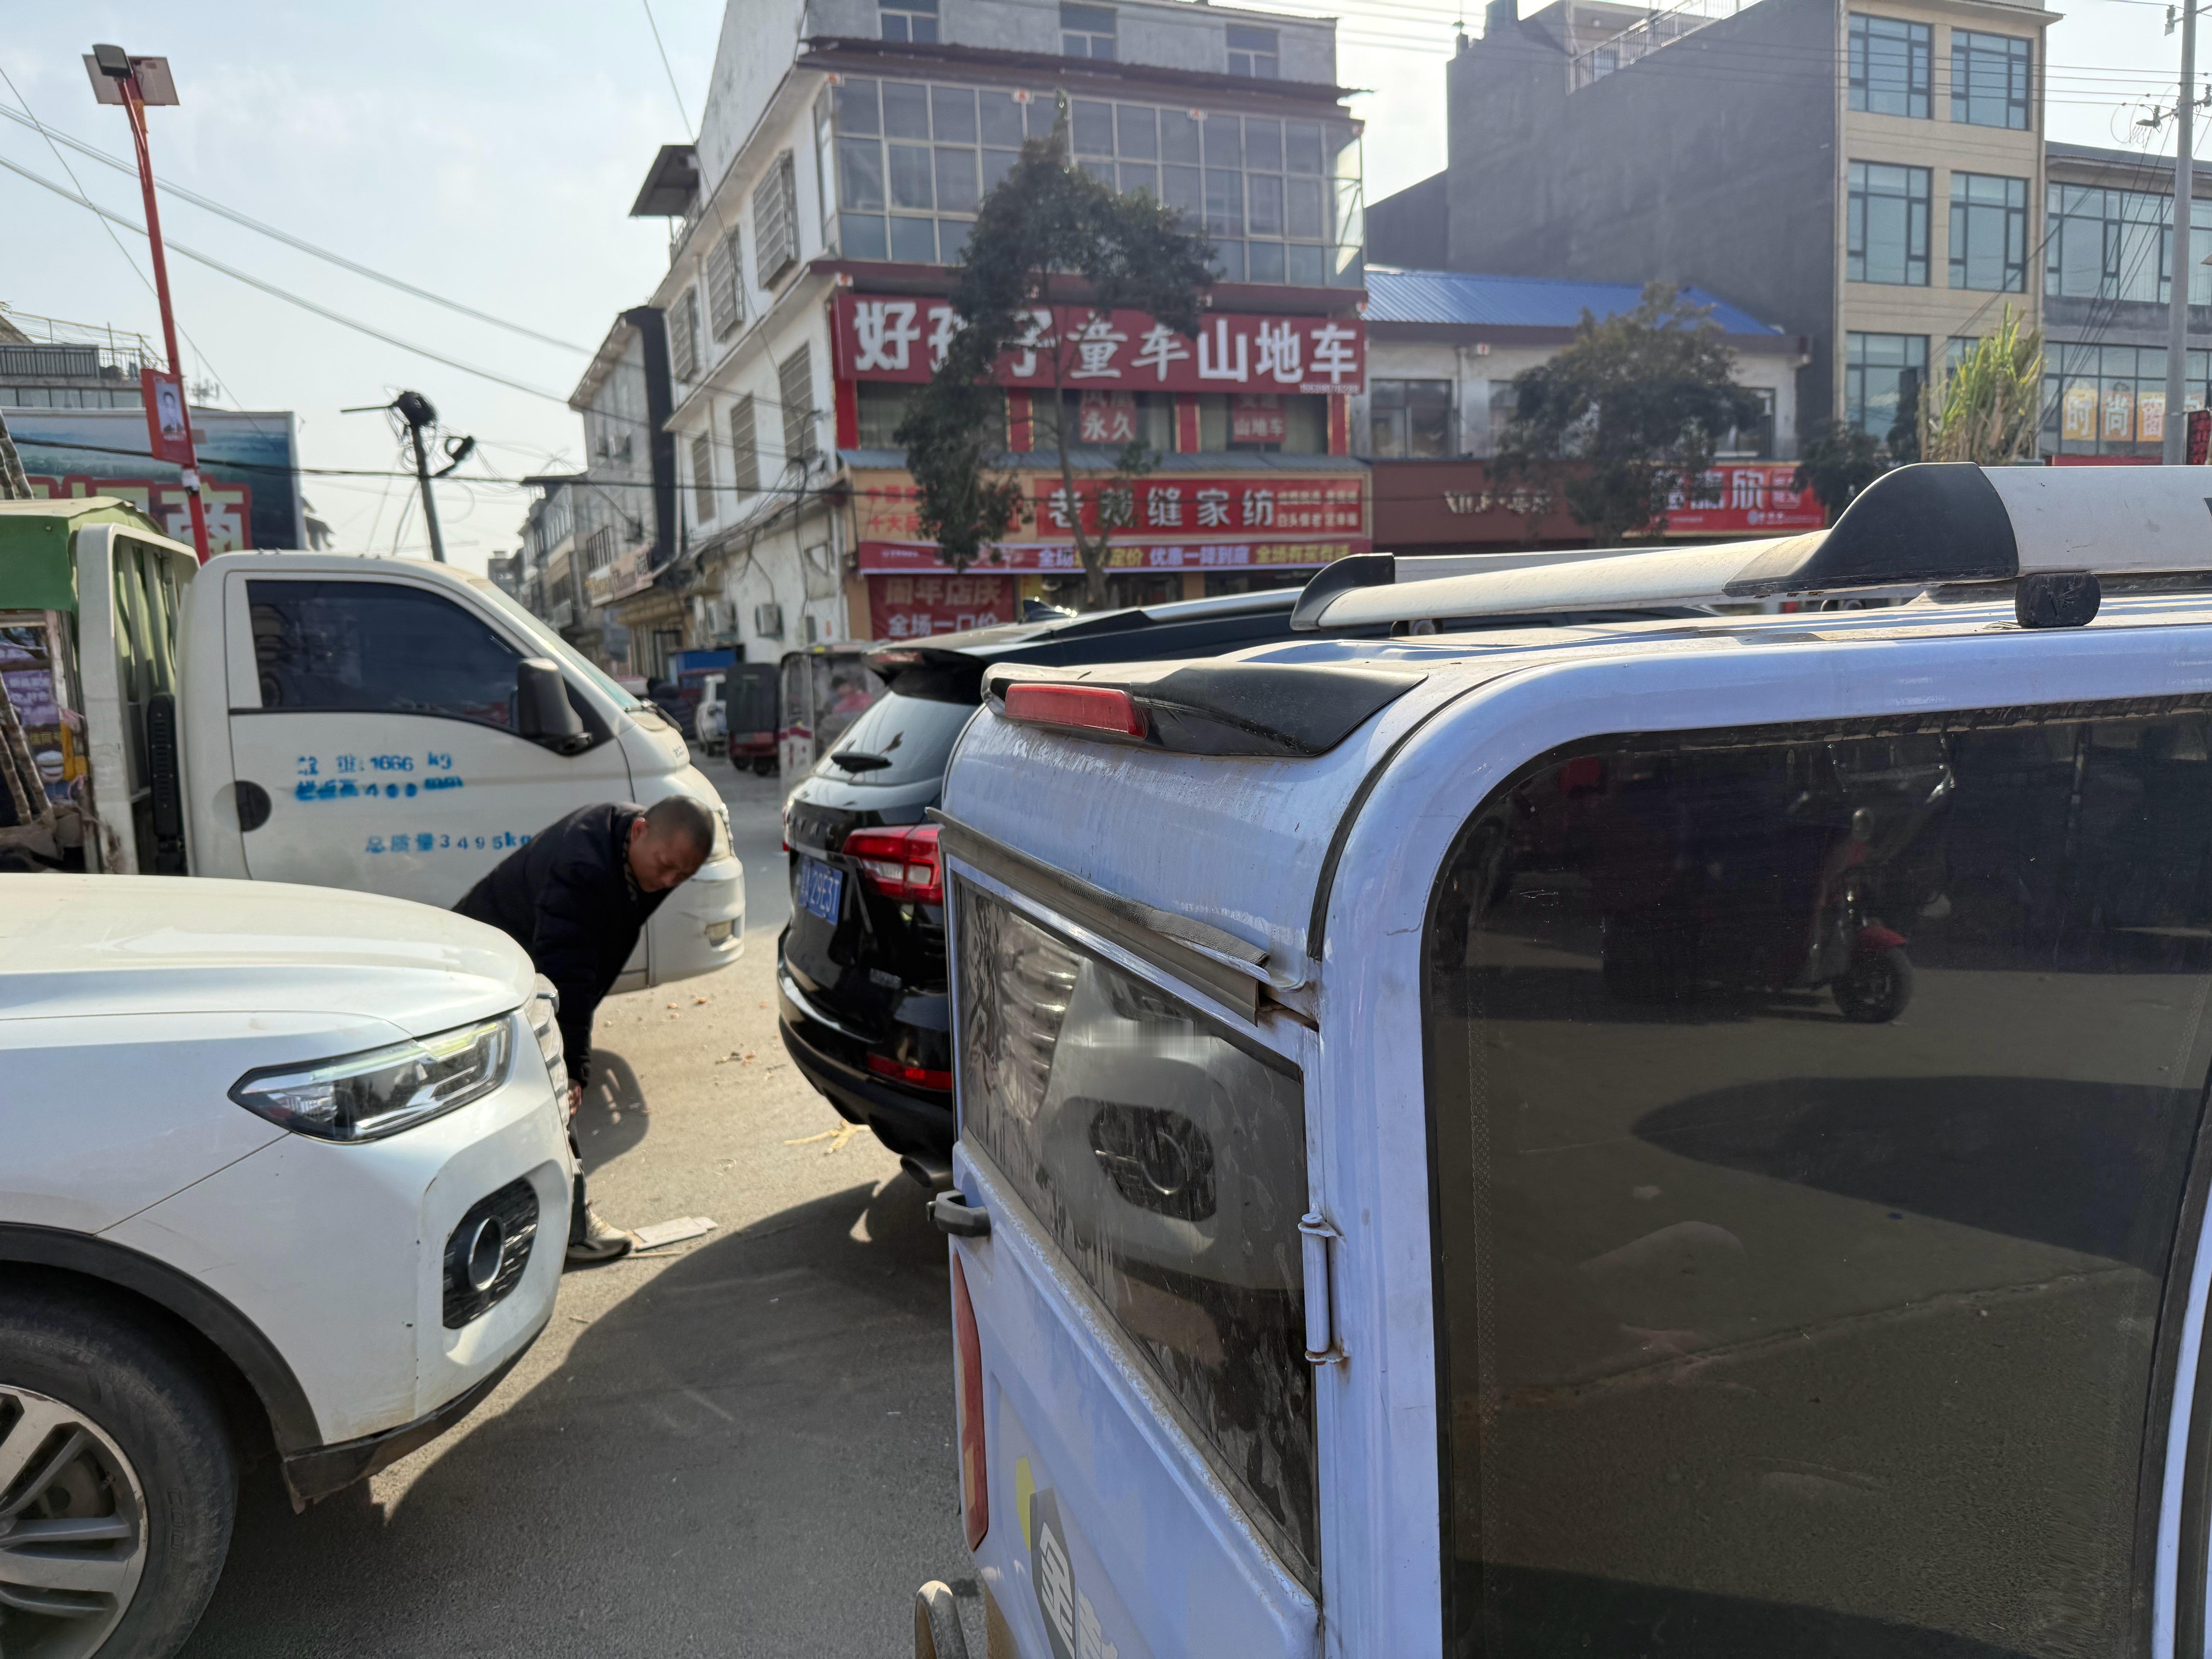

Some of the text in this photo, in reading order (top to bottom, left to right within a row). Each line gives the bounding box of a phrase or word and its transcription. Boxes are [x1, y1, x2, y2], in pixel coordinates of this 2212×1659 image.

[1082, 410, 1134, 441] 永久
[1234, 417, 1283, 436] 山地车
[1038, 547, 1144, 568] 全场定价
[885, 577, 1001, 606] 周年店庆
[888, 612, 999, 637] 全场一口价
[428, 752, 452, 770] kg
